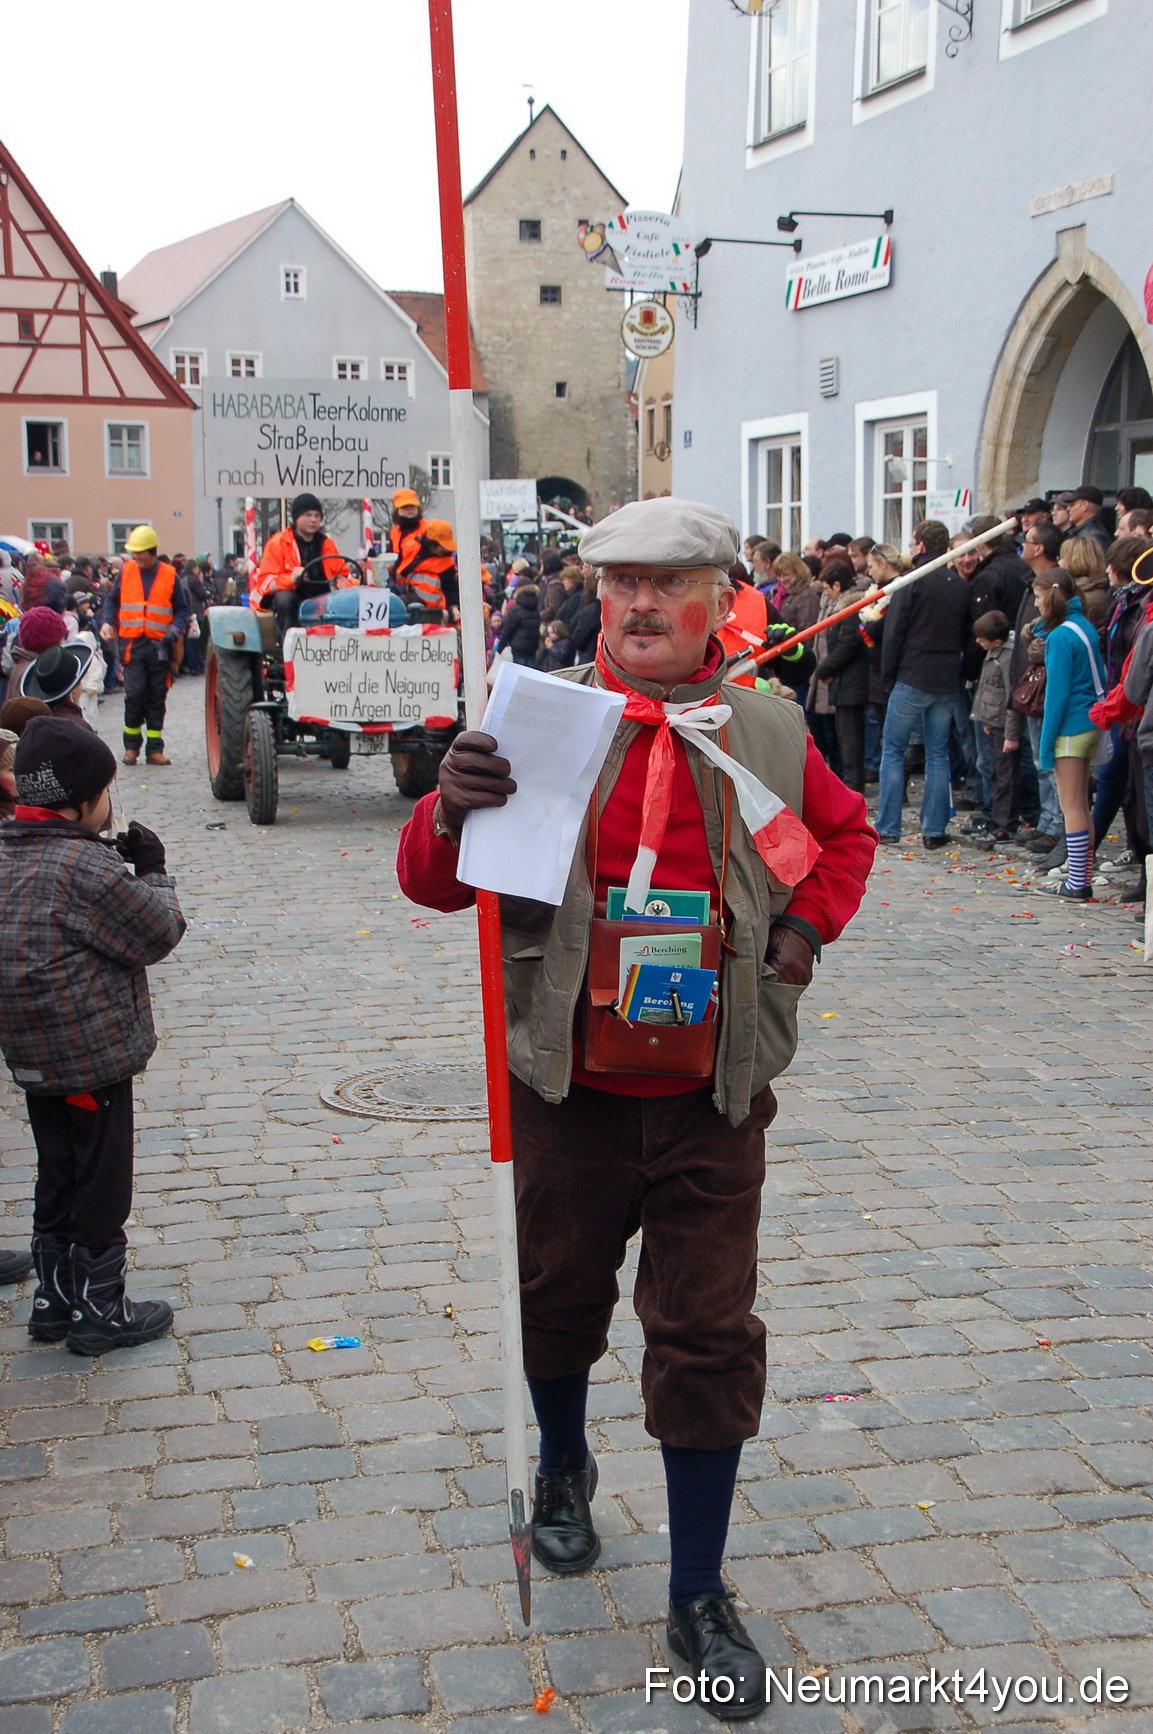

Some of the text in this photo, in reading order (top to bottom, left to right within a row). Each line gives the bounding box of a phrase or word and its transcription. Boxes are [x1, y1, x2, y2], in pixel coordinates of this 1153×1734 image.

[802, 269, 870, 300] Bella Roma
[257, 423, 369, 452] Straßenbau
[218, 454, 406, 488] nach Winterzhofen
[361, 602, 388, 621] 30
[291, 637, 453, 667] Abgefräßt wurde der Belag
[324, 669, 440, 700] weil die Neigung
[330, 696, 421, 722] im Argen lag
[651, 946, 687, 954] Berching
[643, 996, 694, 1009] Bercng
